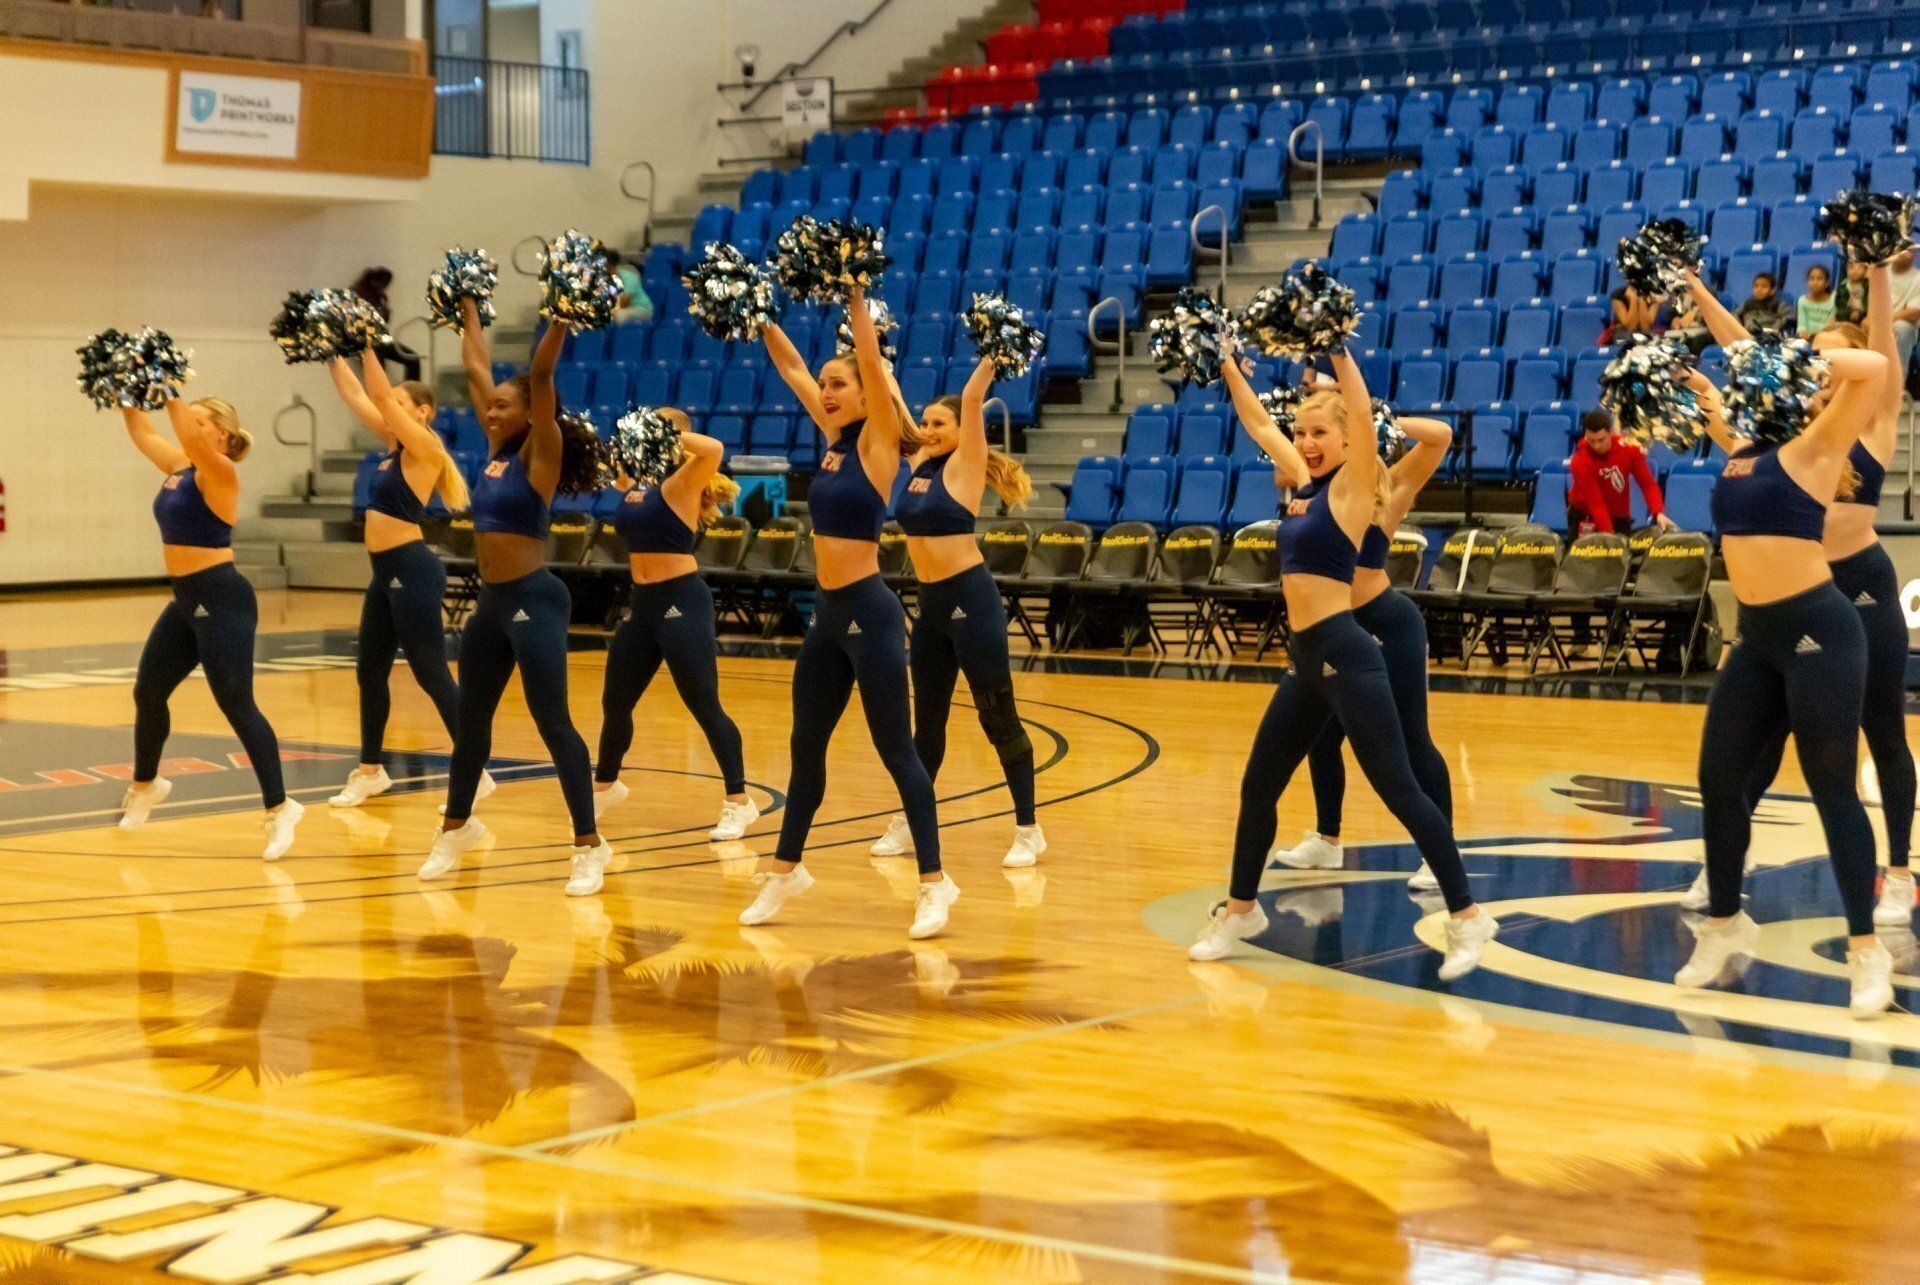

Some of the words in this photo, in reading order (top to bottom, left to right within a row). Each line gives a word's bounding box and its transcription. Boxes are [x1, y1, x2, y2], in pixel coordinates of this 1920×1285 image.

[222, 94, 271, 107] THOMAS
[786, 100, 825, 112] SECTION
[221, 109, 296, 124] PRINTWORKS
[1101, 535, 1150, 547] RoofClaim.com
[1164, 537, 1213, 549] RoofClaim.com
[1501, 541, 1556, 555] RoofClaim.com
[1569, 544, 1624, 558] RoofClaim.com
[1648, 544, 1706, 558] RoofClaim.com
